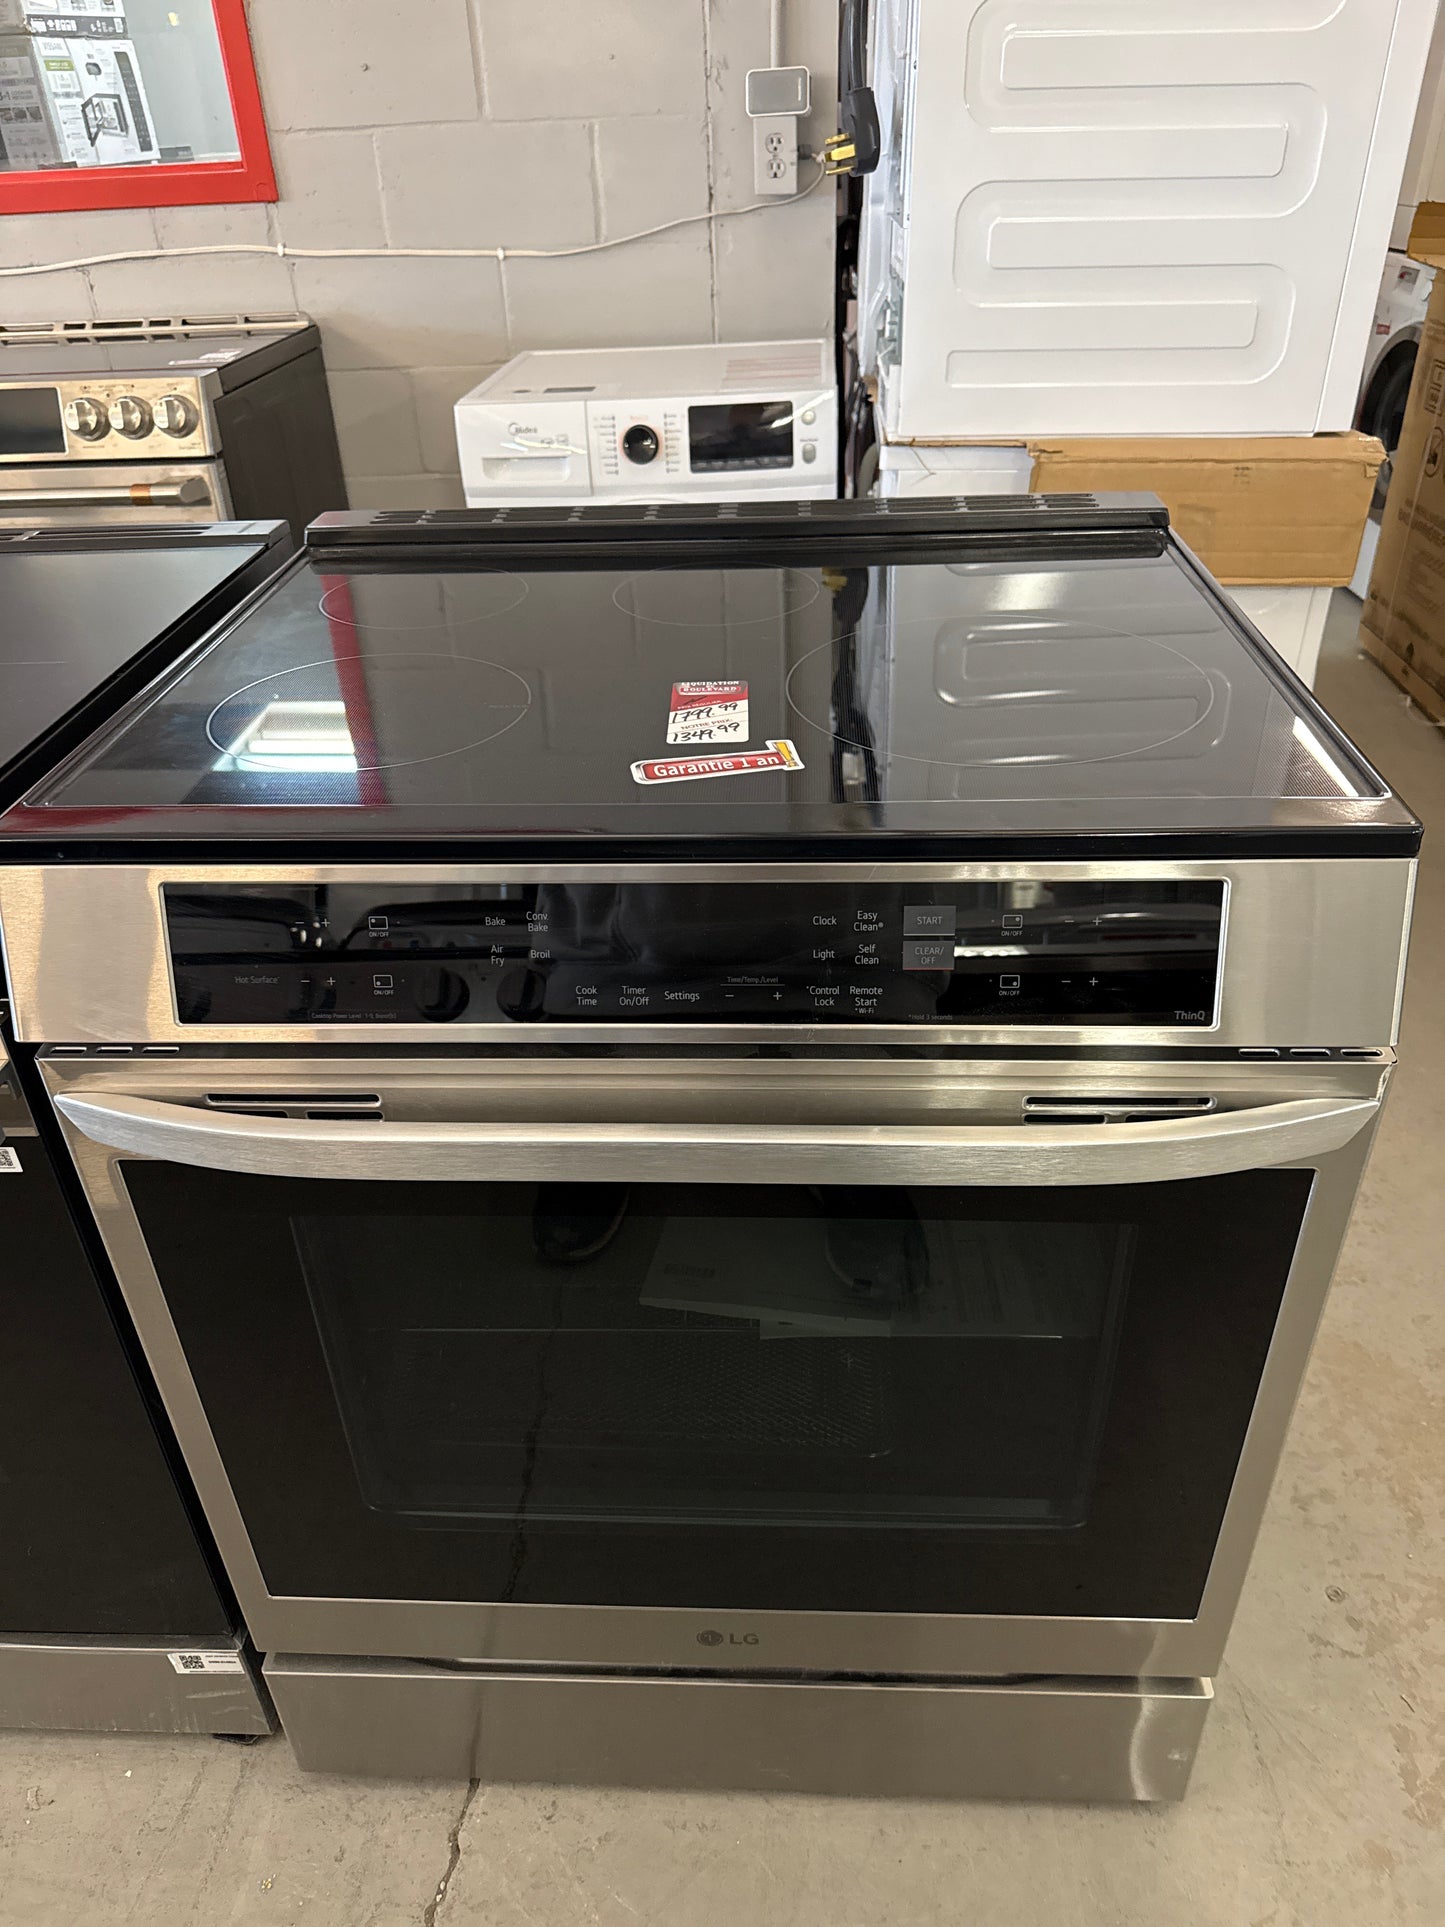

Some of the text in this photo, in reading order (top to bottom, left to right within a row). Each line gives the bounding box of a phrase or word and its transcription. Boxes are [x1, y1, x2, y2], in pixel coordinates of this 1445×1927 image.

[653, 759, 734, 778] Garantie
[740, 757, 751, 768] 1
[756, 754, 780, 766] an
[485, 916, 506, 926] Bake
[812, 915, 837, 926] Clock
[857, 910, 878, 921] Easy
[916, 916, 943, 925] START
[527, 922, 549, 932] Bake
[490, 943, 504, 953] Air
[530, 948, 551, 959] Broil
[858, 943, 876, 954] Self
[812, 949, 836, 961] Light
[854, 955, 879, 965] Clean
[920, 956, 937, 965] OFF
[490, 955, 505, 967] Fry
[575, 985, 598, 995] Cook
[621, 985, 647, 995] Timer
[849, 985, 884, 995] Remote
[576, 996, 598, 1006] Time
[619, 996, 650, 1007] On/Off
[664, 990, 701, 1003] Settings
[814, 996, 836, 1007] Lock
[855, 996, 878, 1007] Start
[1174, 1010, 1206, 1021] ThinQ
[729, 1632, 760, 1645] LG
